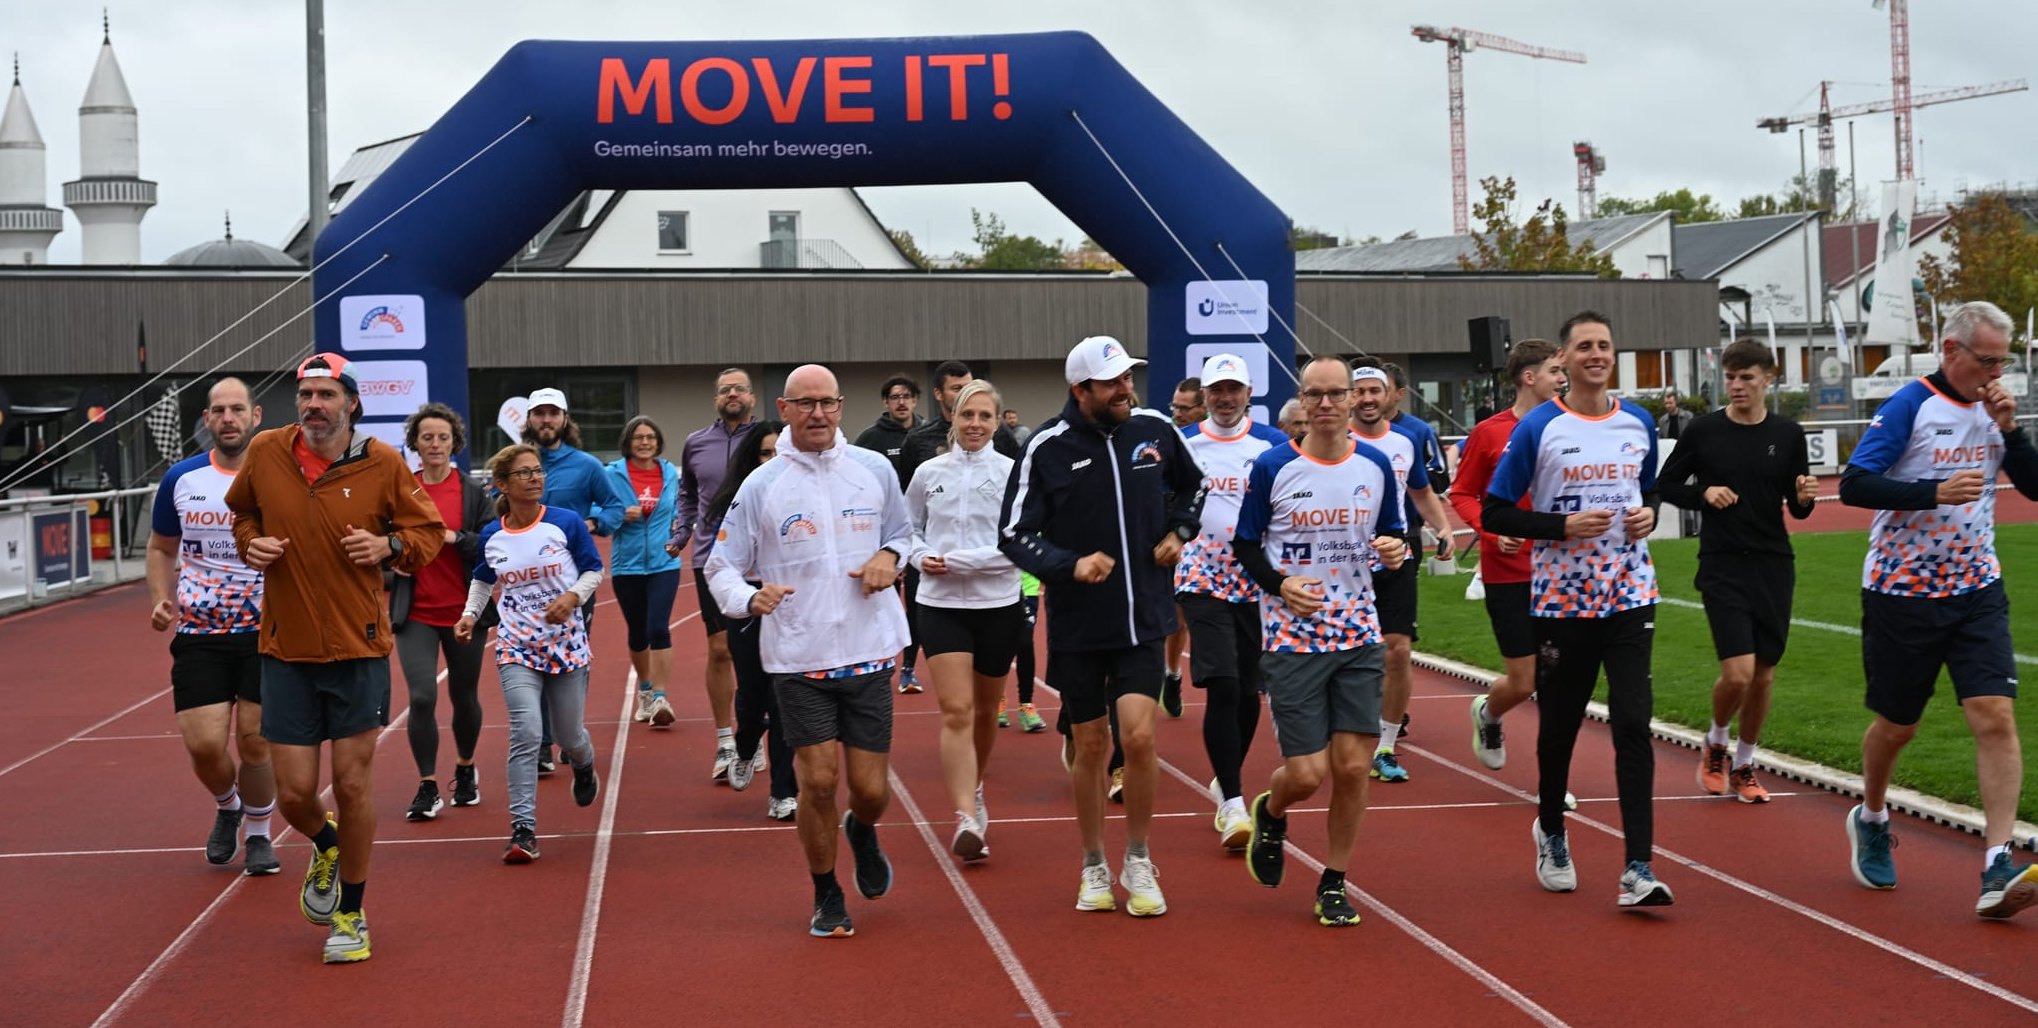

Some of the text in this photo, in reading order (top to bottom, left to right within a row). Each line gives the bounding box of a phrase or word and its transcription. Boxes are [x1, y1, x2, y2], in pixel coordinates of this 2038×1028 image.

[597, 53, 1013, 126] MOVE IT!
[594, 138, 873, 160] Gemeinsam mehr bewegen.
[360, 381, 415, 396] BWGV
[1932, 445, 1985, 465] MOVE
[1562, 464, 1618, 482] MOVE
[1293, 491, 1313, 500] JAKO
[1292, 508, 1350, 528] MOVE
[209, 550, 219, 559] in
[1329, 553, 1347, 564] der
[544, 563, 562, 578] IT!
